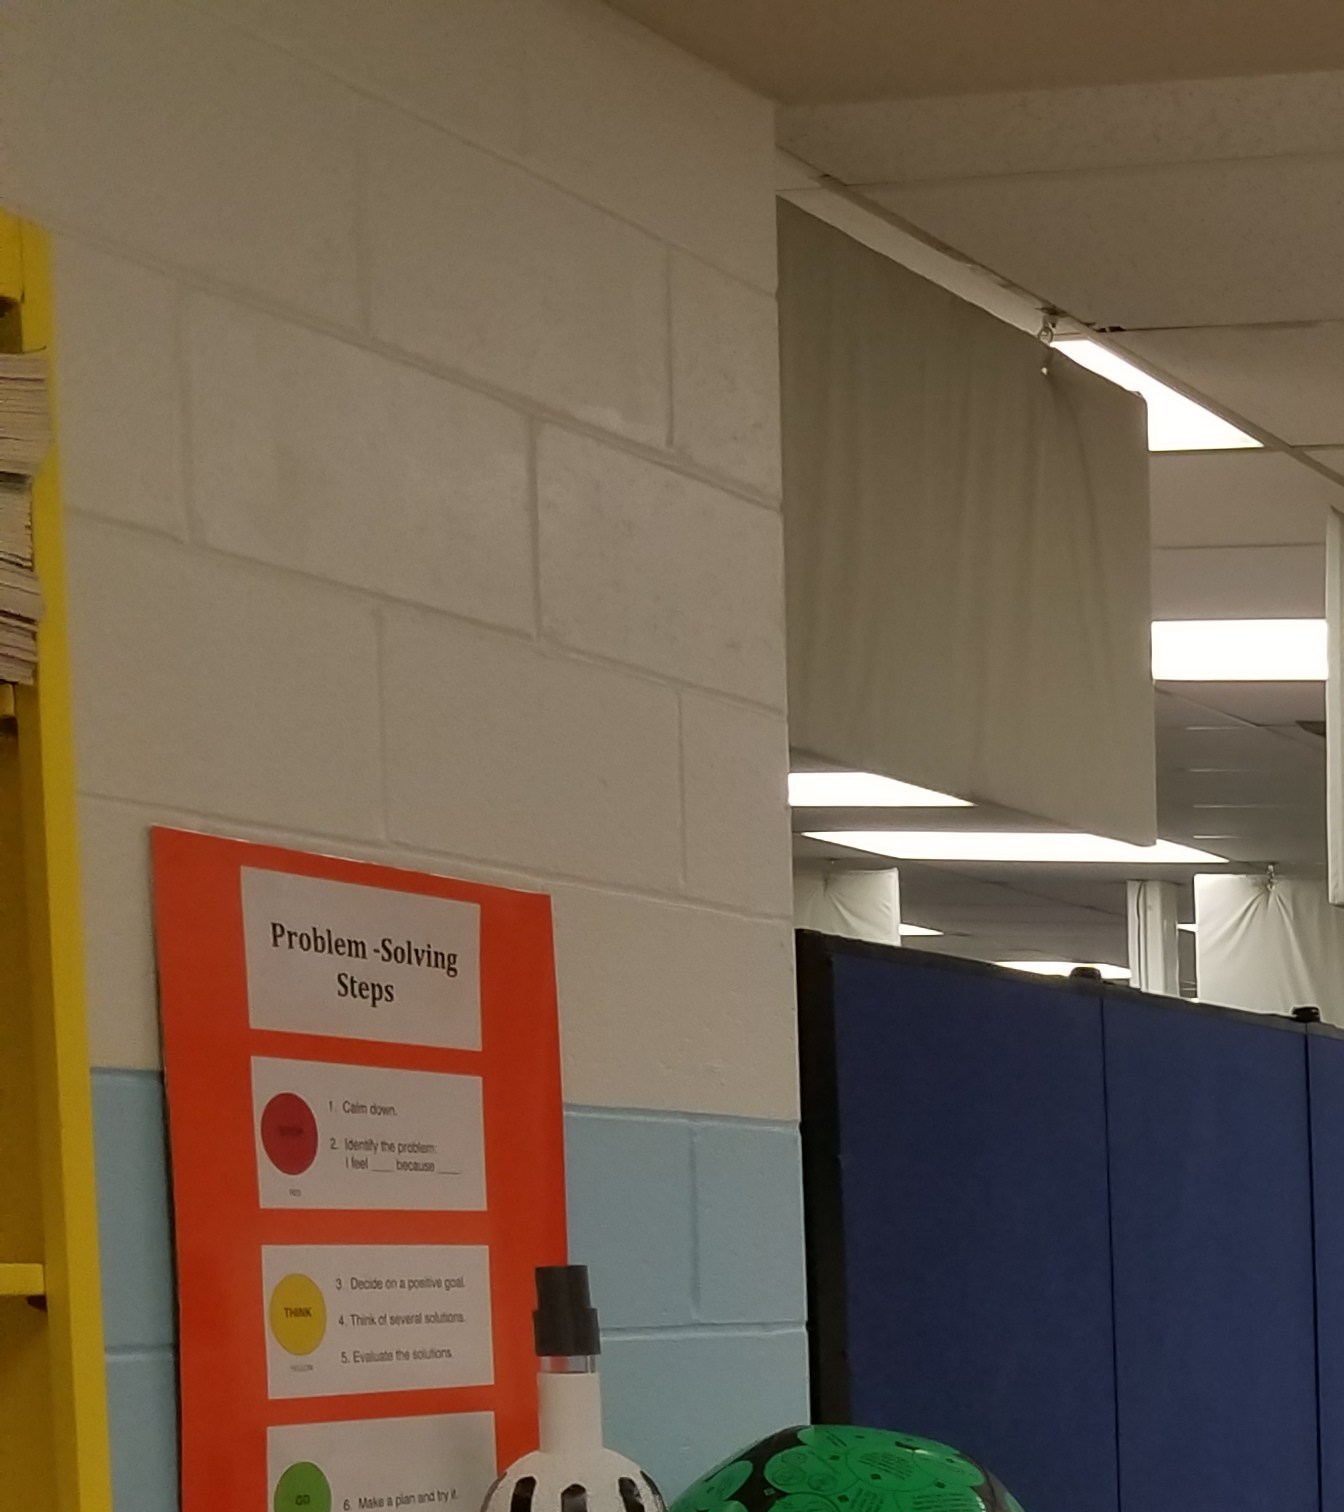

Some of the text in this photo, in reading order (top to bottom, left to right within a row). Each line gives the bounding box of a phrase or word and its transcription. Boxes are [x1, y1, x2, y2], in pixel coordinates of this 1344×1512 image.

[270, 921, 368, 960] Problem
[337, 972, 395, 1007] Steps
[342, 1100, 367, 1115] Calm
[381, 1141, 396, 1153] the
[351, 1156, 369, 1170] feel
[396, 1159, 435, 1172] because
[350, 1277, 383, 1290] Decide
[385, 1279, 398, 1290] on
[399, 1279, 407, 1289] a
[408, 1276, 442, 1291] positive
[284, 1306, 313, 1319] THINK
[350, 1313, 377, 1327] Think
[378, 1313, 387, 1326] of
[389, 1312, 422, 1326] several
[353, 1350, 393, 1363] Evaluate
[395, 1349, 410, 1361] the
[358, 1495, 385, 1510] Make
[387, 1497, 394, 1507] a
[395, 1493, 416, 1509] plan
[418, 1492, 435, 1504] and
[437, 1490, 449, 1504] try
